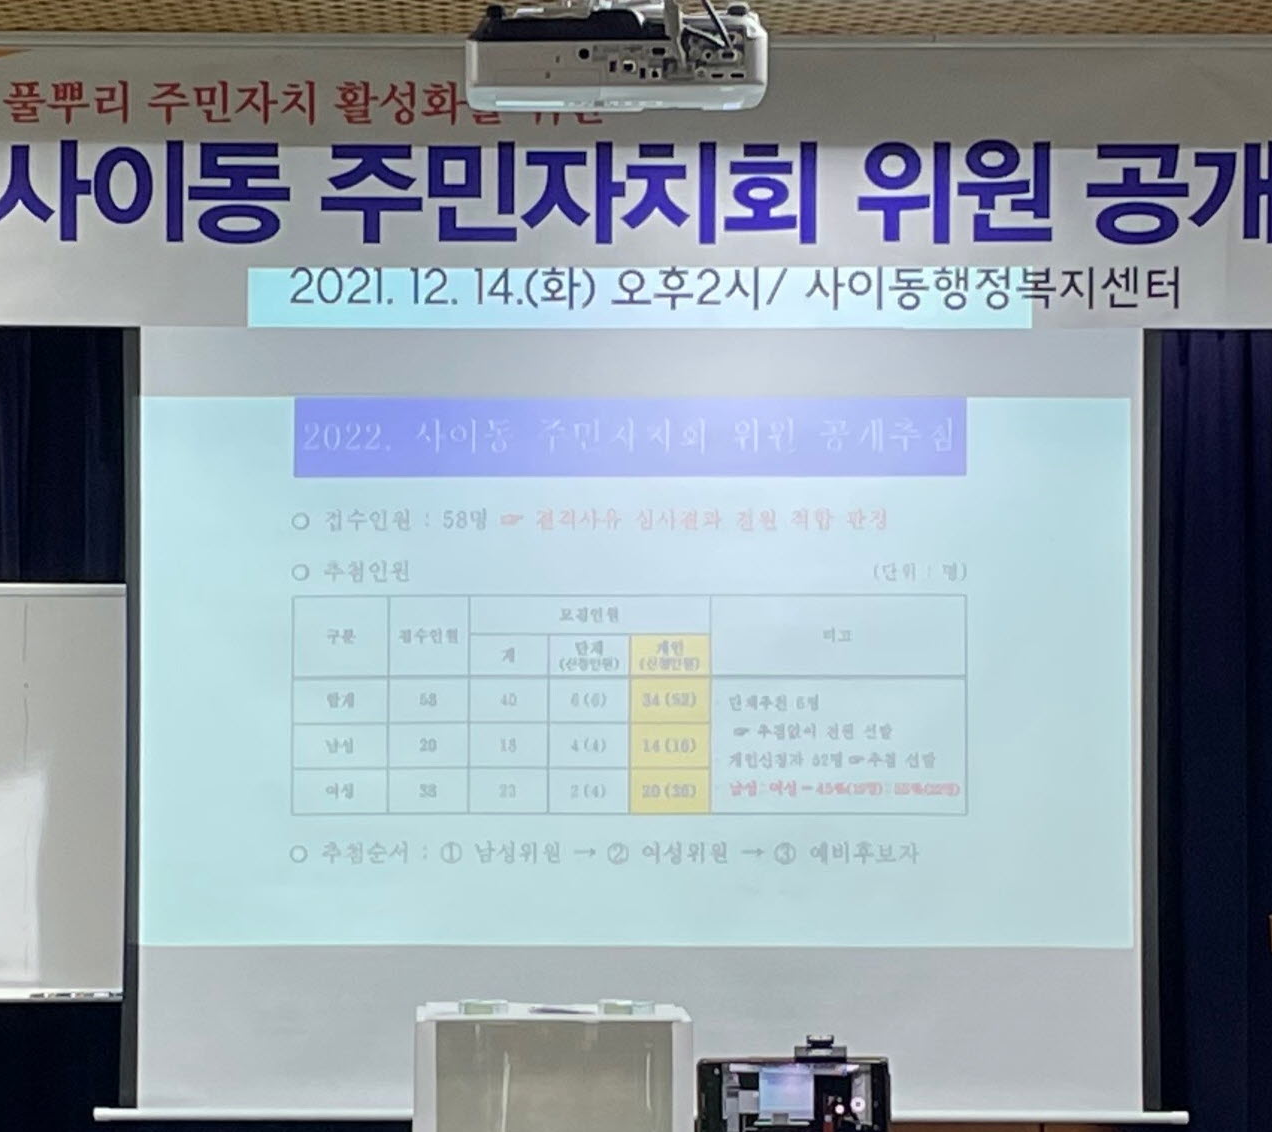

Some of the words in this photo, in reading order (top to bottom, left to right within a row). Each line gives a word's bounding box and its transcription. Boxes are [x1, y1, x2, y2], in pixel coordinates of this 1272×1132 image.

[2, 79, 130, 125] 풀뿌리
[146, 80, 318, 126] 주민자치
[321, 139, 817, 245] 주민자치회
[857, 139, 1055, 244] 위원
[289, 268, 394, 307] 2021.
[410, 268, 460, 307] 12.
[474, 266, 596, 310] 14.(화)
[805, 265, 1181, 311] 사이동행정복지센터
[303, 420, 391, 453] 2022.
[415, 417, 514, 454] 사이동
[734, 416, 795, 454] 위원
[325, 508, 413, 532] 접수인원
[442, 508, 488, 531] 58명
[323, 560, 411, 584] 추첨인원
[322, 841, 409, 866] 추첨순서
[474, 840, 561, 866] 남성위원
[641, 840, 728, 866] 여성위원
